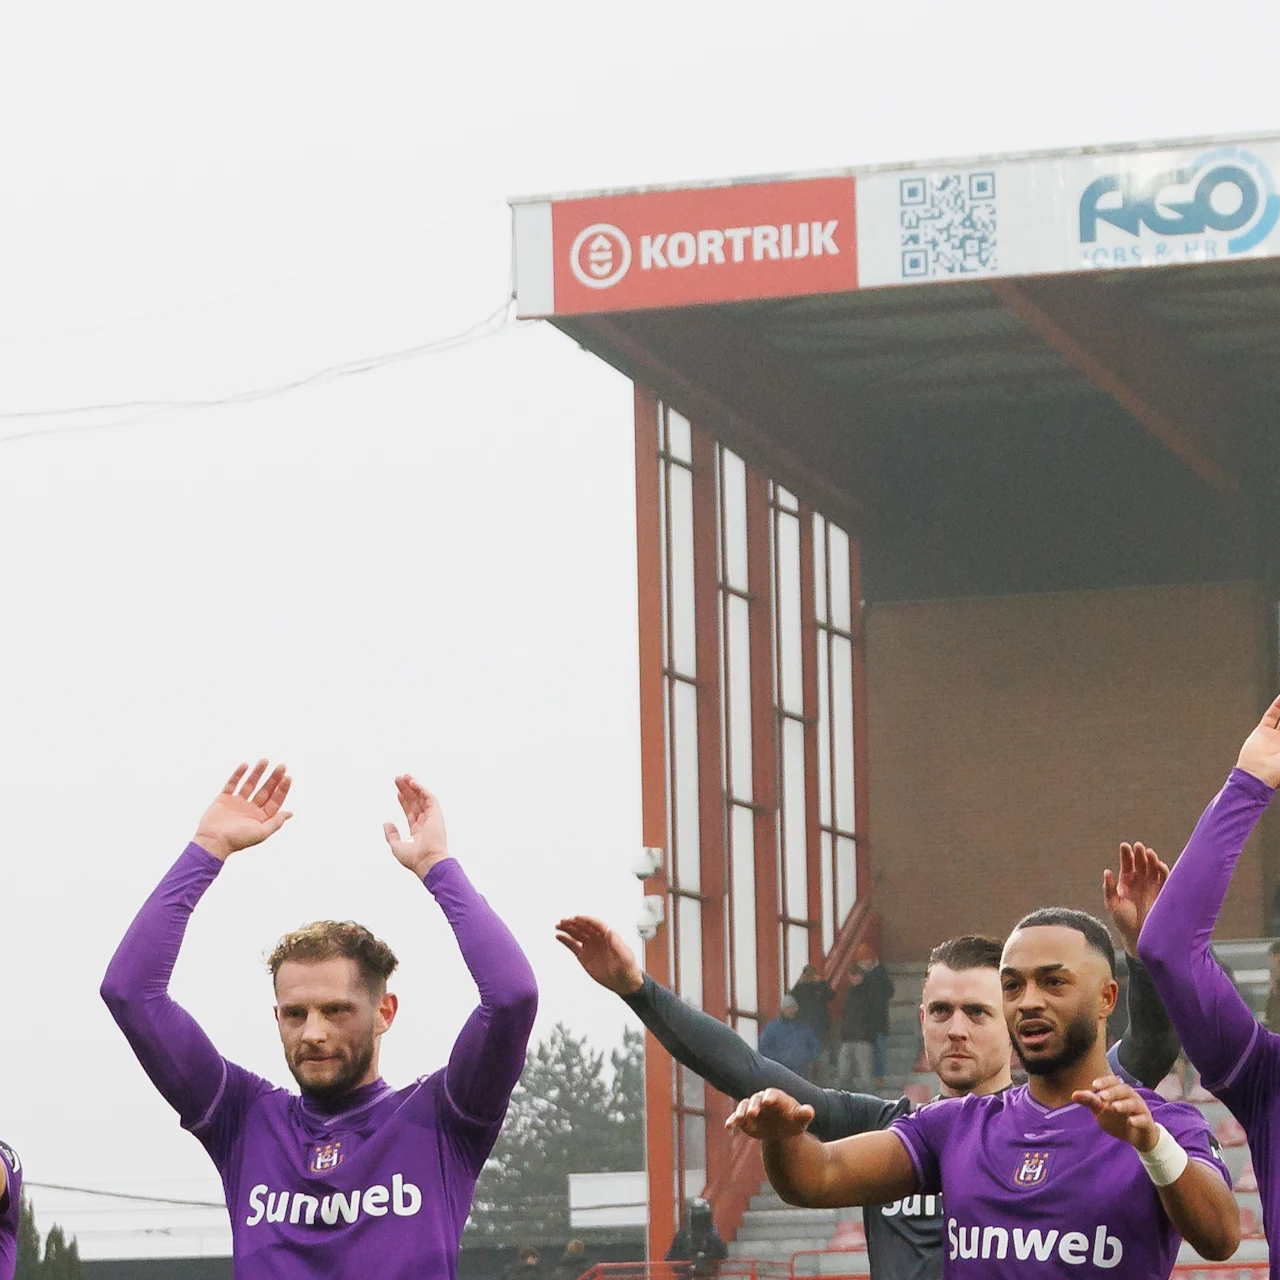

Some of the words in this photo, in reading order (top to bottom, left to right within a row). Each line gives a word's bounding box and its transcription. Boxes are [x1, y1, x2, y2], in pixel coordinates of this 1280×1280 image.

[640, 219, 841, 271] KORTRIJK
[246, 1173, 423, 1227] Sunweb
[948, 1217, 1124, 1269] Sunweb
